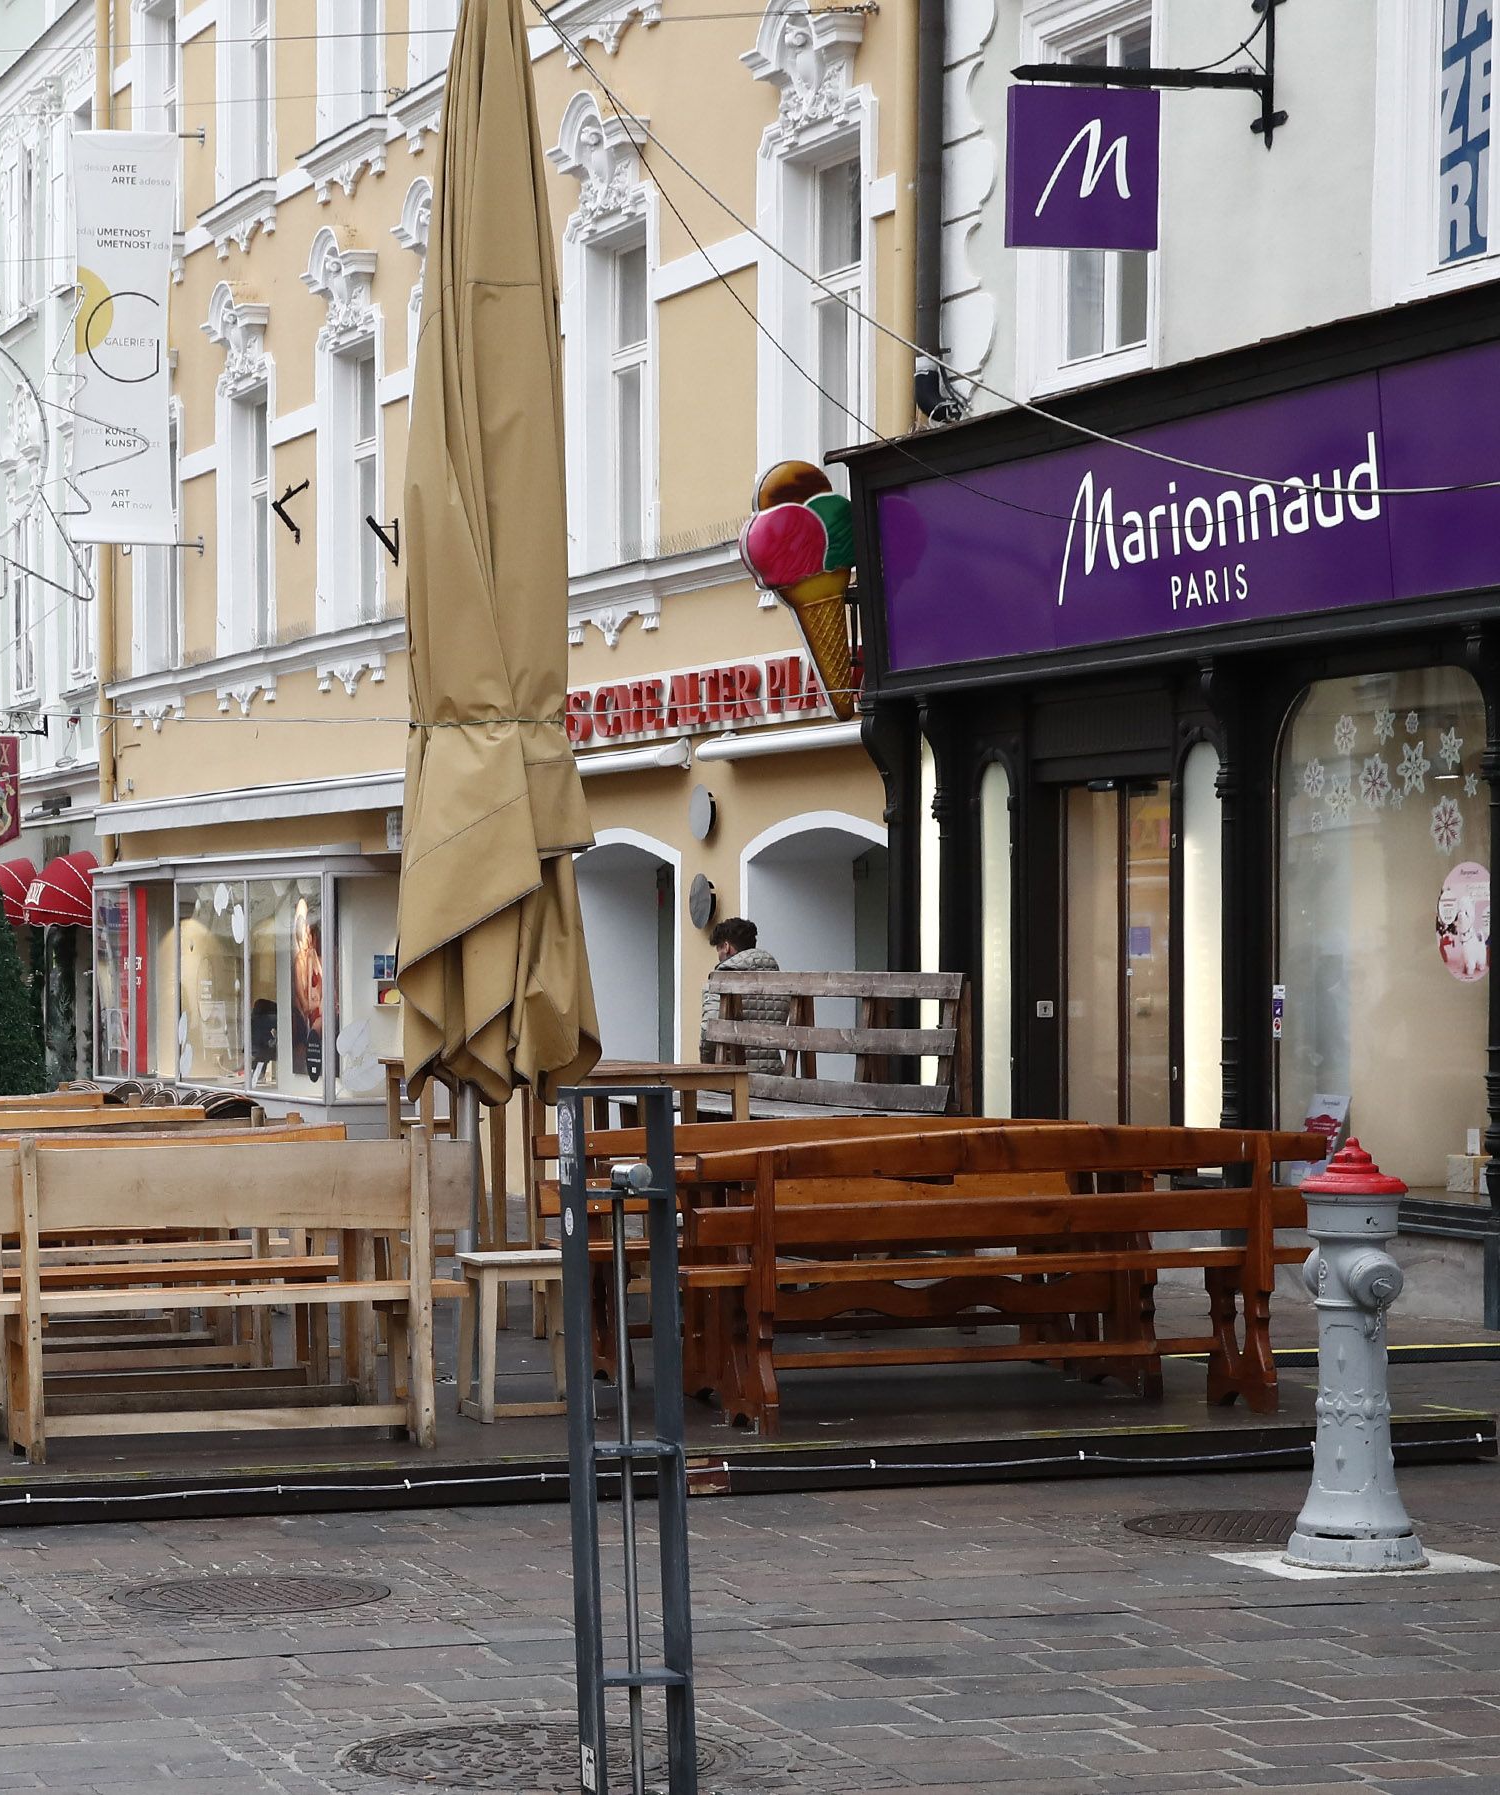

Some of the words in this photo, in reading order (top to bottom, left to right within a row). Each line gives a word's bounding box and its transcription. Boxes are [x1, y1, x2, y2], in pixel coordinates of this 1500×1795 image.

[112, 164, 137, 173] ARTE
[1034, 118, 1132, 217] M
[112, 176, 137, 185] ARTE
[139, 177, 171, 187] adesso
[97, 227, 151, 238] UMETNOST
[97, 239, 151, 250] UMETNOST
[104, 337, 146, 347] GALERIE
[148, 338, 155, 347] 3
[105, 439, 137, 447] KUNST
[111, 489, 130, 497] ART
[111, 500, 130, 508] ART
[1058, 431, 1381, 606] Marionnaud
[1170, 563, 1248, 610] PARIS
[565, 691, 593, 742] S
[666, 664, 764, 728] ALTER
